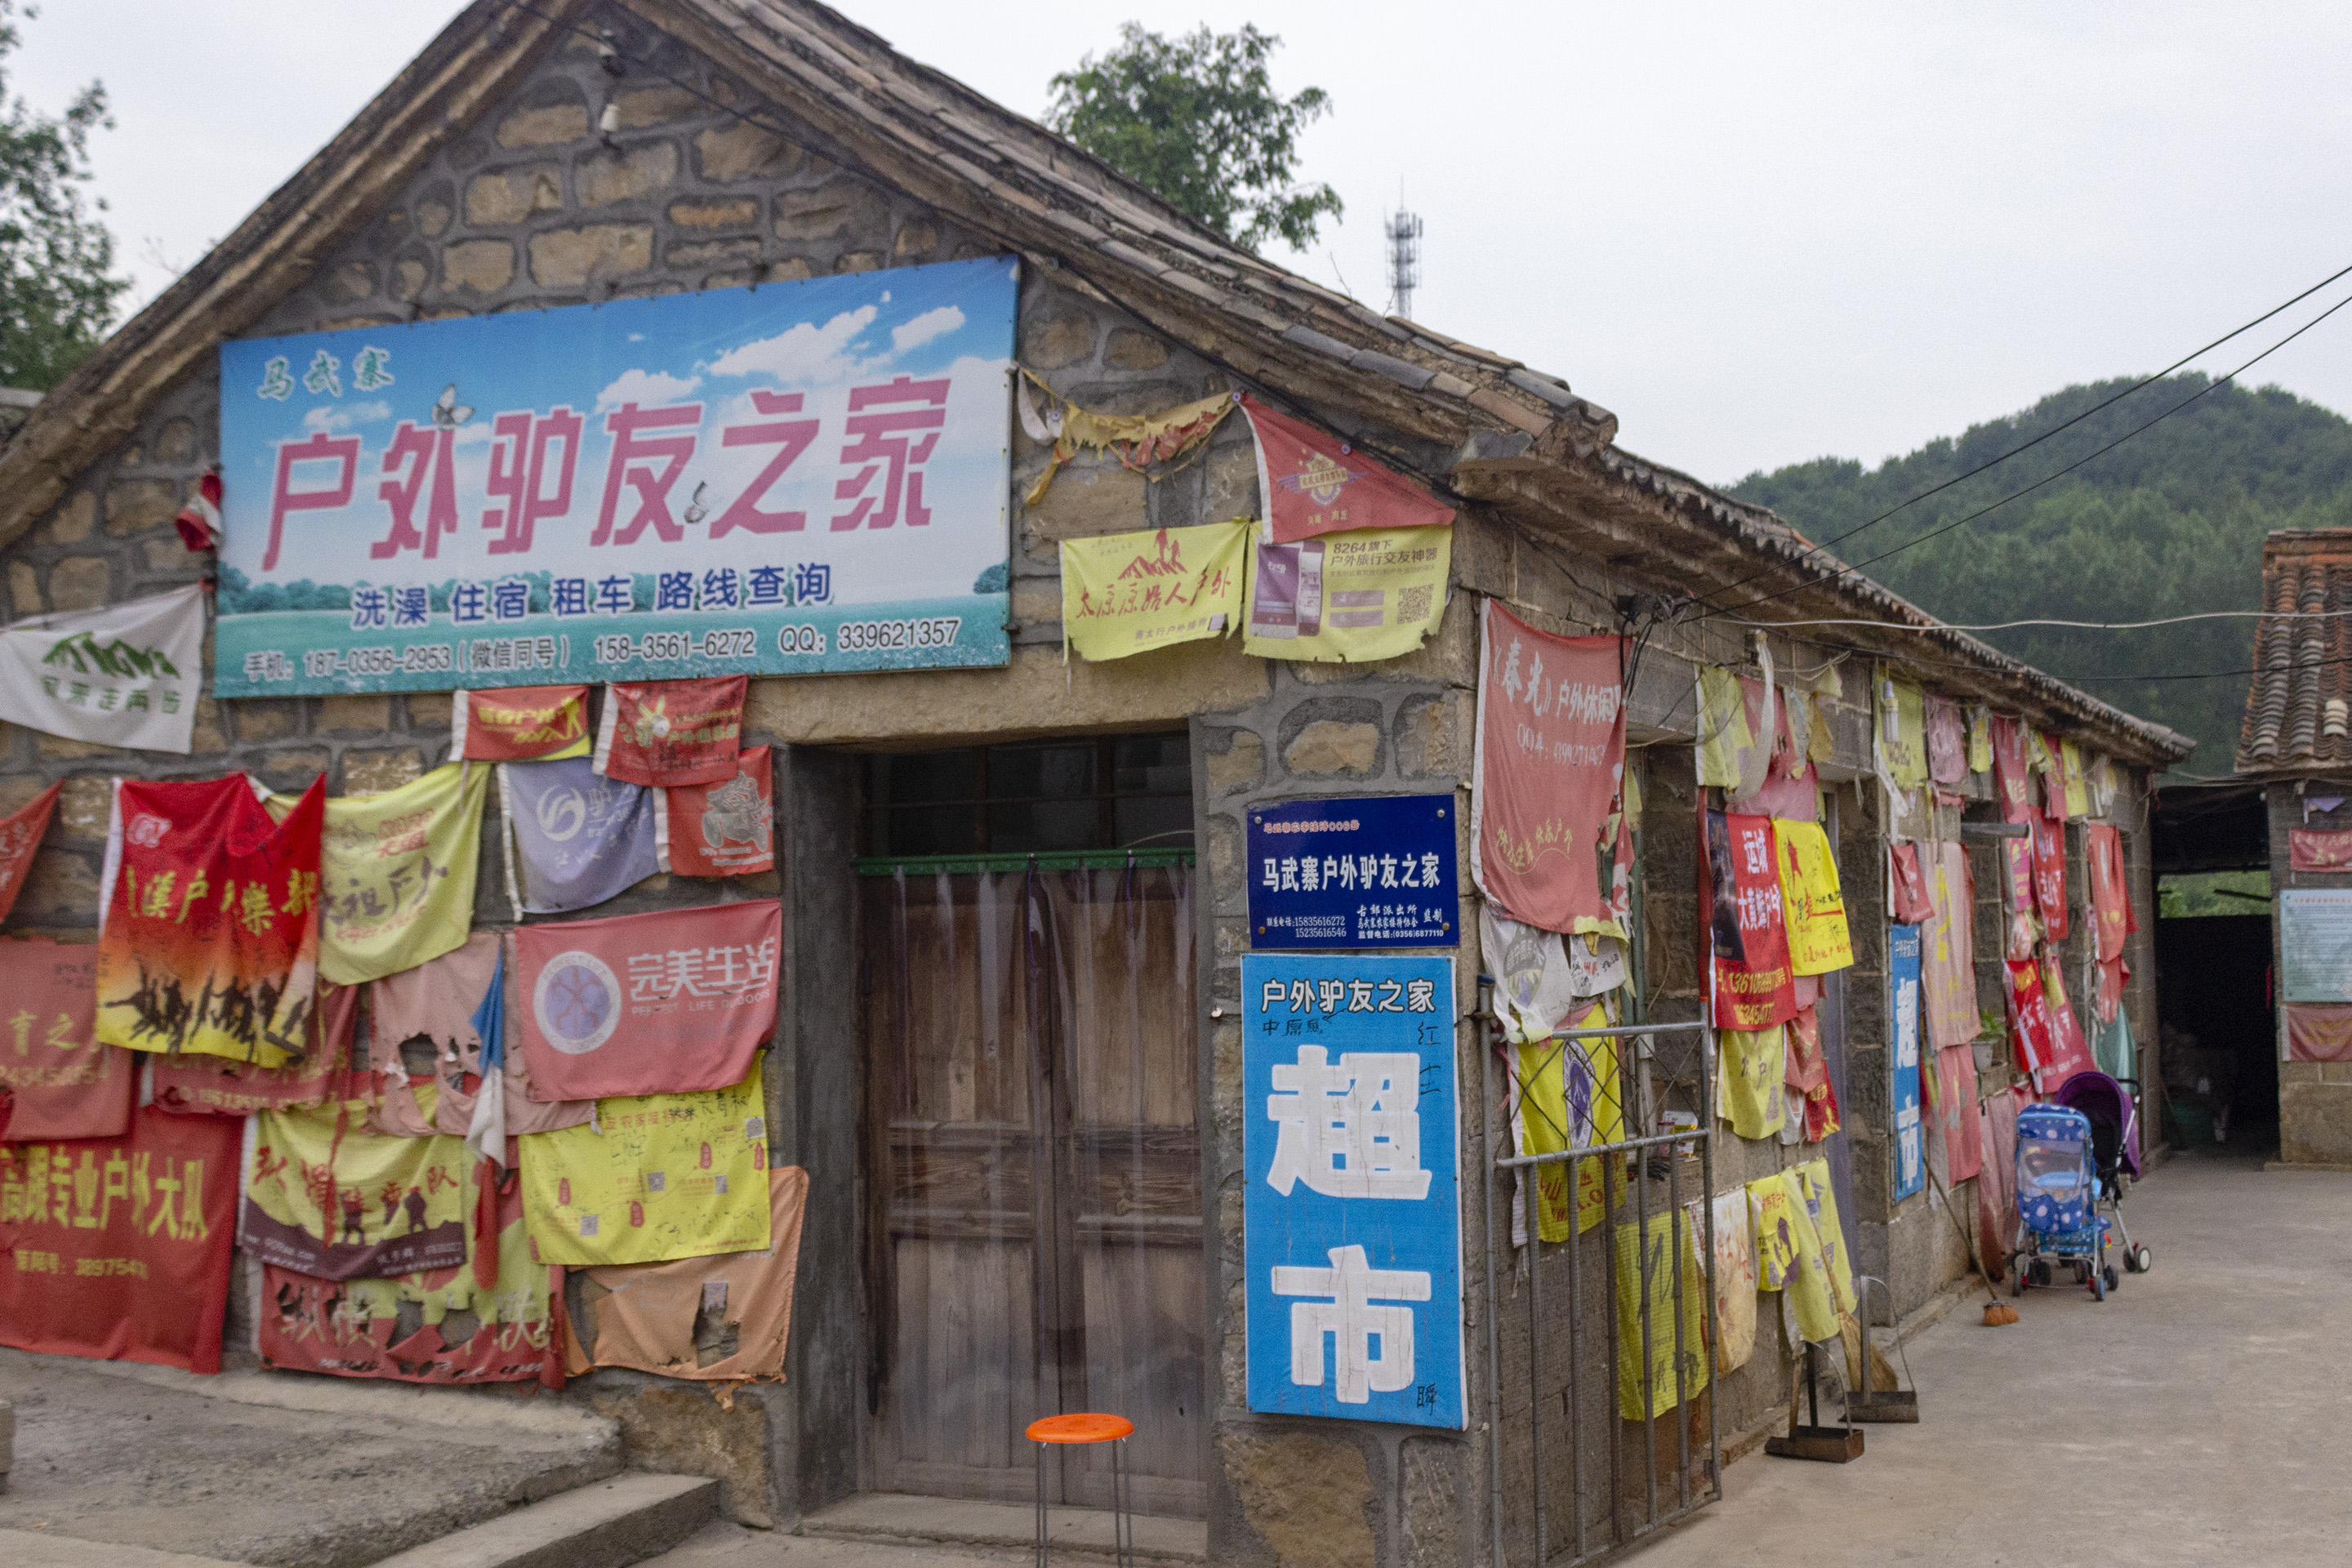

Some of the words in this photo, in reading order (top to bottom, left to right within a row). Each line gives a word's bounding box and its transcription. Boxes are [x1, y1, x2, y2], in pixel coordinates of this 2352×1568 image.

[257, 346, 394, 400] 马武寨
[260, 376, 952, 573] 户外驴友之家
[1330, 547, 1438, 568] 户外旅行交友神器
[1333, 538, 1393, 555] 8264旗下
[353, 586, 430, 629] 洗澡
[450, 580, 532, 625] 住宿
[550, 574, 635, 618] 租车
[657, 561, 833, 611] 路线查询
[594, 627, 756, 663] 158-3561-6272
[1263, 852, 1441, 893] 马武寨户外驴友之家
[1295, 927, 1347, 938] 15235616546
[1423, 907, 1443, 924] 监制
[627, 936, 775, 1002] 完美生活
[688, 1000, 715, 1012] LIFE
[1261, 977, 1436, 1013] 户外驴友之家
[1267, 1045, 1432, 1404] 超市
